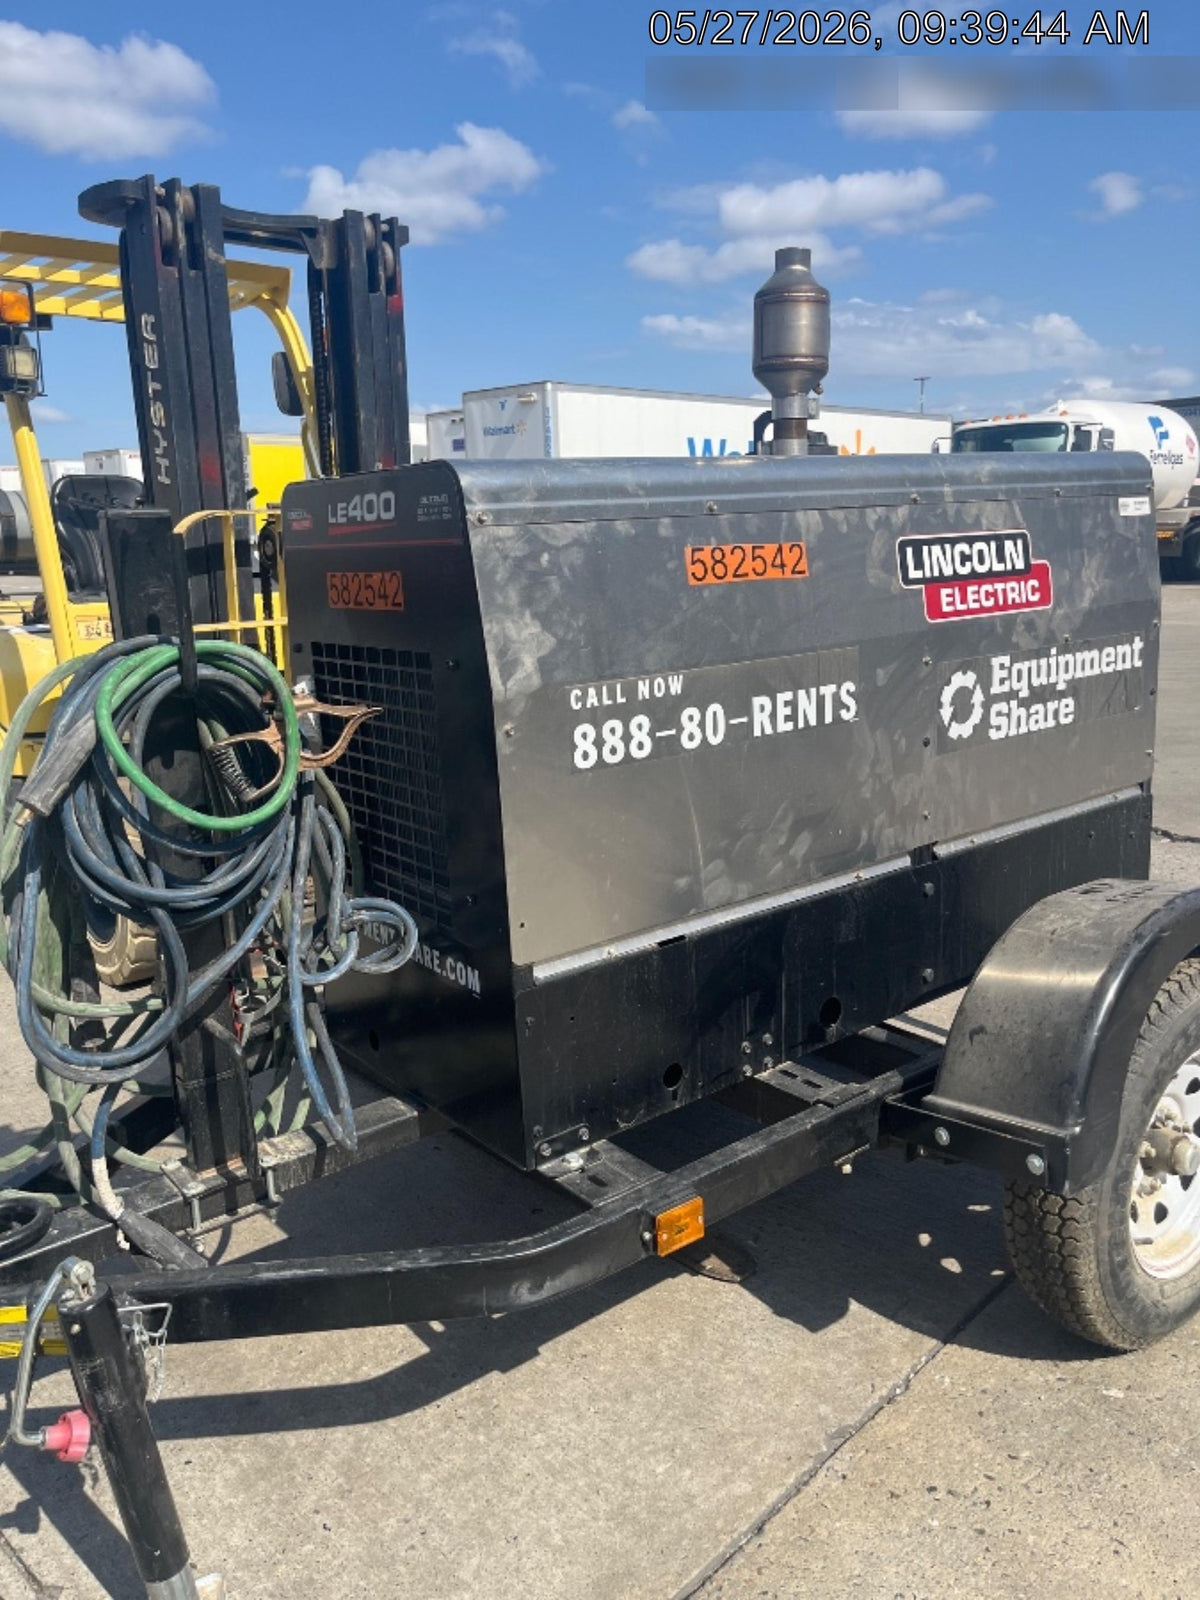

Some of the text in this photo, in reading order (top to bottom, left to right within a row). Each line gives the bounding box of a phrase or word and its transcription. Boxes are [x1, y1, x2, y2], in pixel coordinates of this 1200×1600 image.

[141, 312, 171, 485] HYSTER
[328, 490, 396, 524] LE400
[690, 543, 807, 582] 582542
[905, 538, 1025, 579] LINCOLN
[329, 571, 403, 608] 582542
[940, 579, 1041, 613] ELECTRIC
[990, 636, 1145, 698] Equipment
[569, 674, 685, 710] CALL NOW
[572, 681, 858, 769] 888-80-RENTS
[988, 696, 1075, 740] Share
